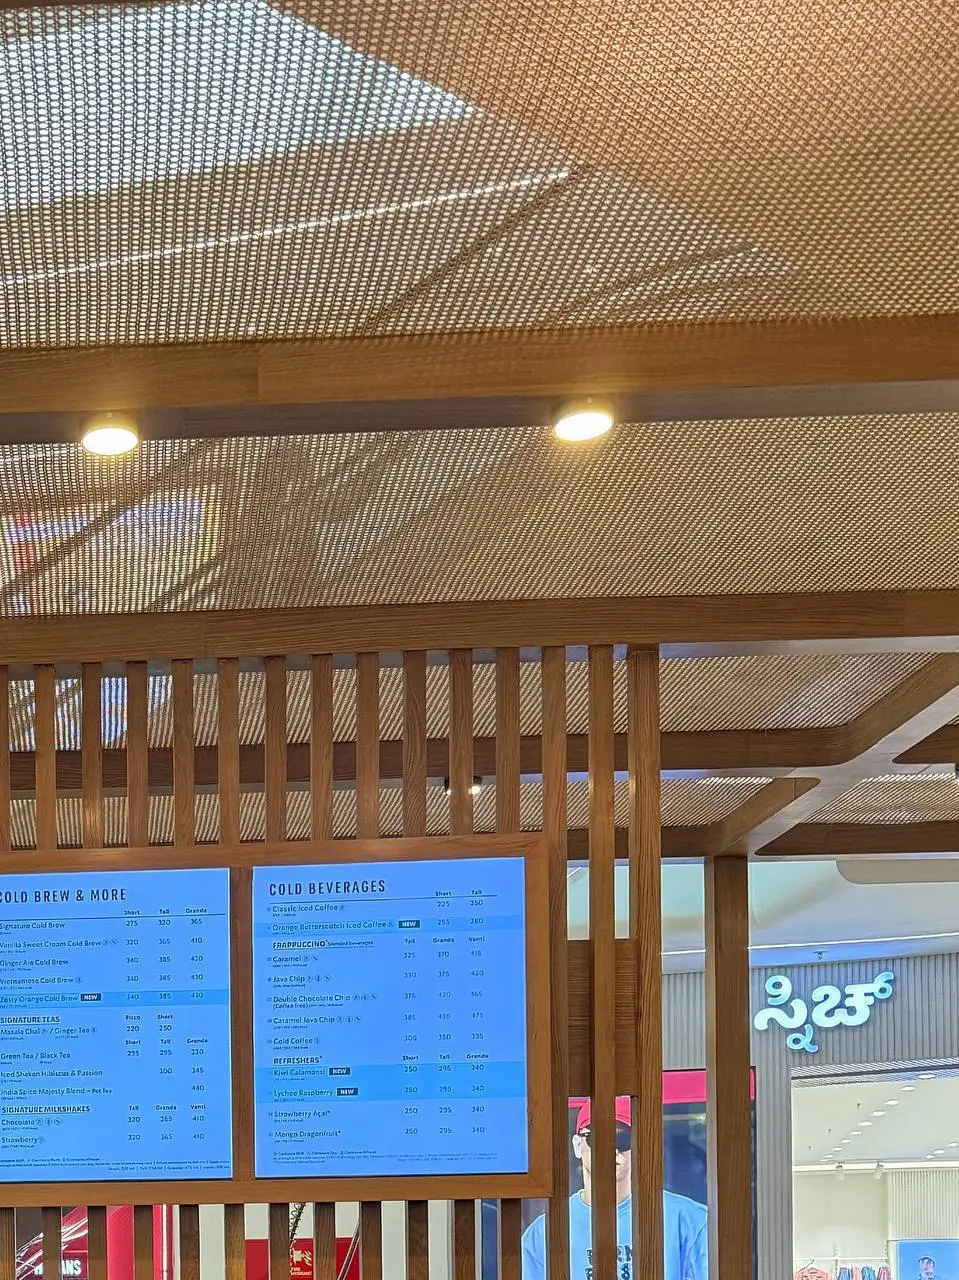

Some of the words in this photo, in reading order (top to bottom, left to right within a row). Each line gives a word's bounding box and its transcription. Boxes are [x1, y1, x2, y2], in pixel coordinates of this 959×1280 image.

[269, 883, 302, 896] COLD
[309, 879, 386, 895] BEVERAGES
[35, 890, 69, 902] BREW
[76, 889, 85, 901] &
[90, 888, 126, 901] MORE
[0, 922, 30, 931] Signature
[48, 921, 65, 929] Brew
[1, 1052, 21, 1060] Green
[44, 1105, 90, 1113] MILKSHAKES
